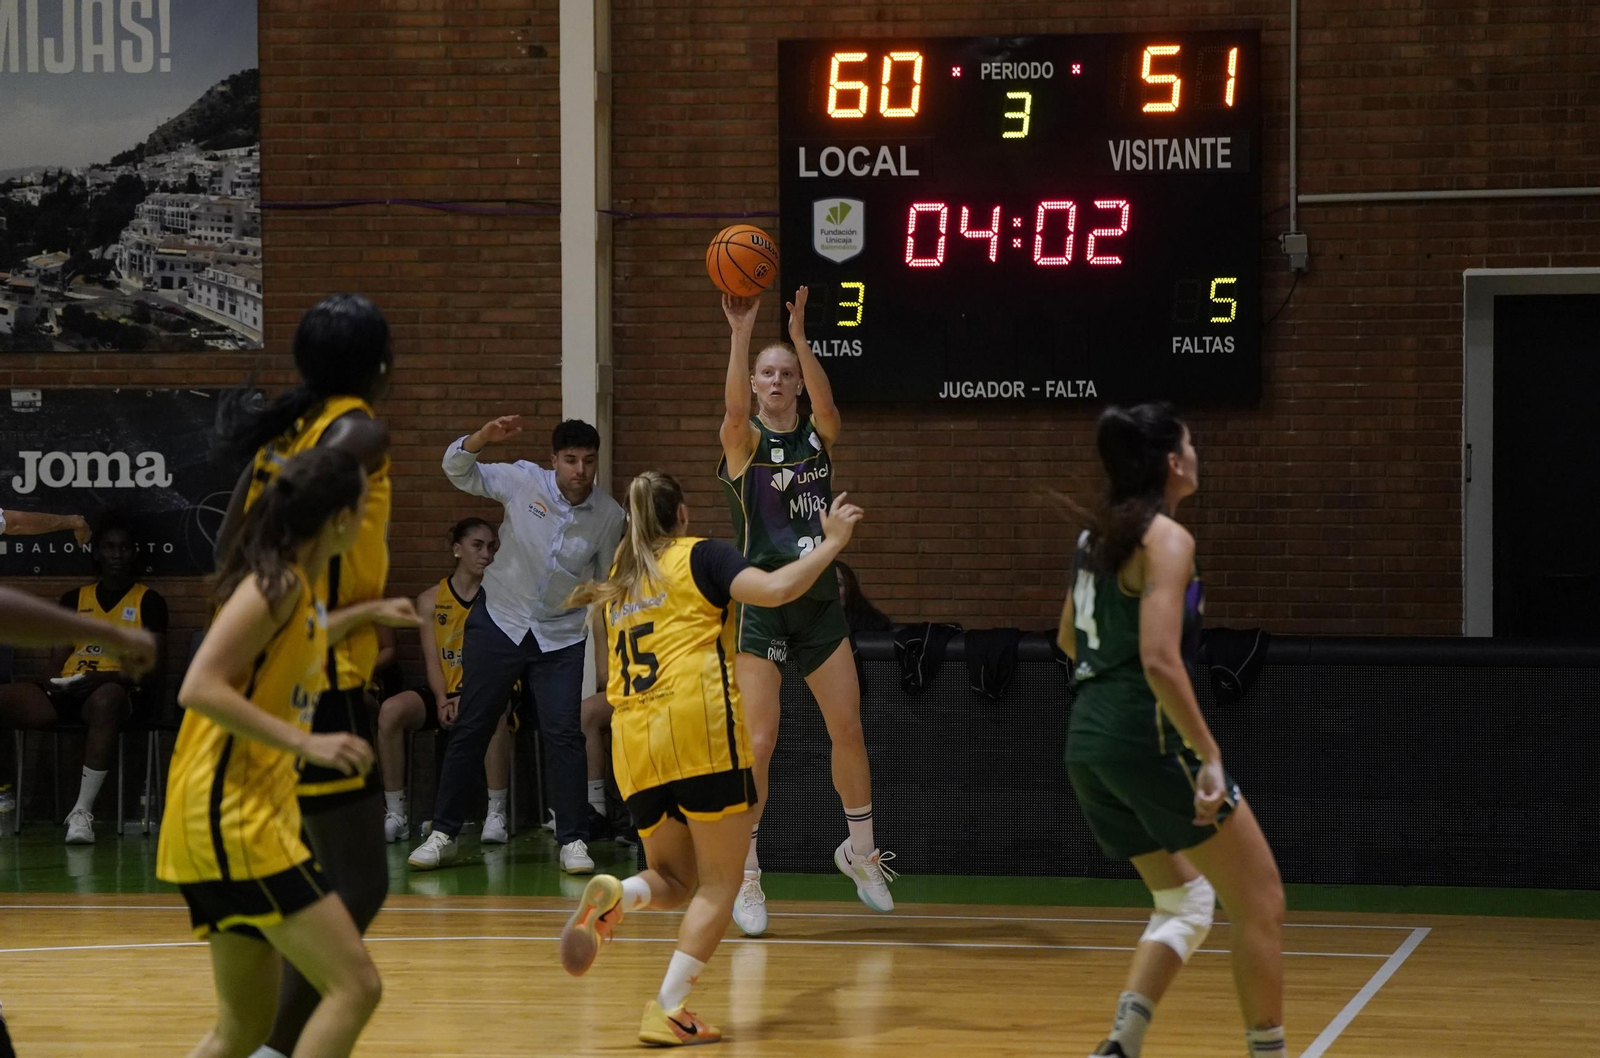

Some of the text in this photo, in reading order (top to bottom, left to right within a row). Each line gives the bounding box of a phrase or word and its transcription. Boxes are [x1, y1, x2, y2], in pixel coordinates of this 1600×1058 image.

[826, 50, 924, 119] 60
[980, 61, 1054, 80] PERIODO
[1140, 44, 1239, 113] 51
[1002, 92, 1032, 138] 3
[798, 145, 920, 178] LOCAL
[1108, 136, 1232, 171] VISITANTE
[820, 228, 857, 236] Fundación
[825, 237, 852, 245] Unicaja
[905, 199, 1130, 267] 04:02
[837, 282, 865, 326] 3
[1210, 278, 1237, 323] 5
[806, 339, 863, 357] ALTAS
[1172, 335, 1235, 354] FALTAS
[938, 380, 1026, 399] JUGADOR
[1045, 380, 1098, 398] FALTA
[789, 491, 828, 521] Mijas
[615, 621, 659, 697] 15
